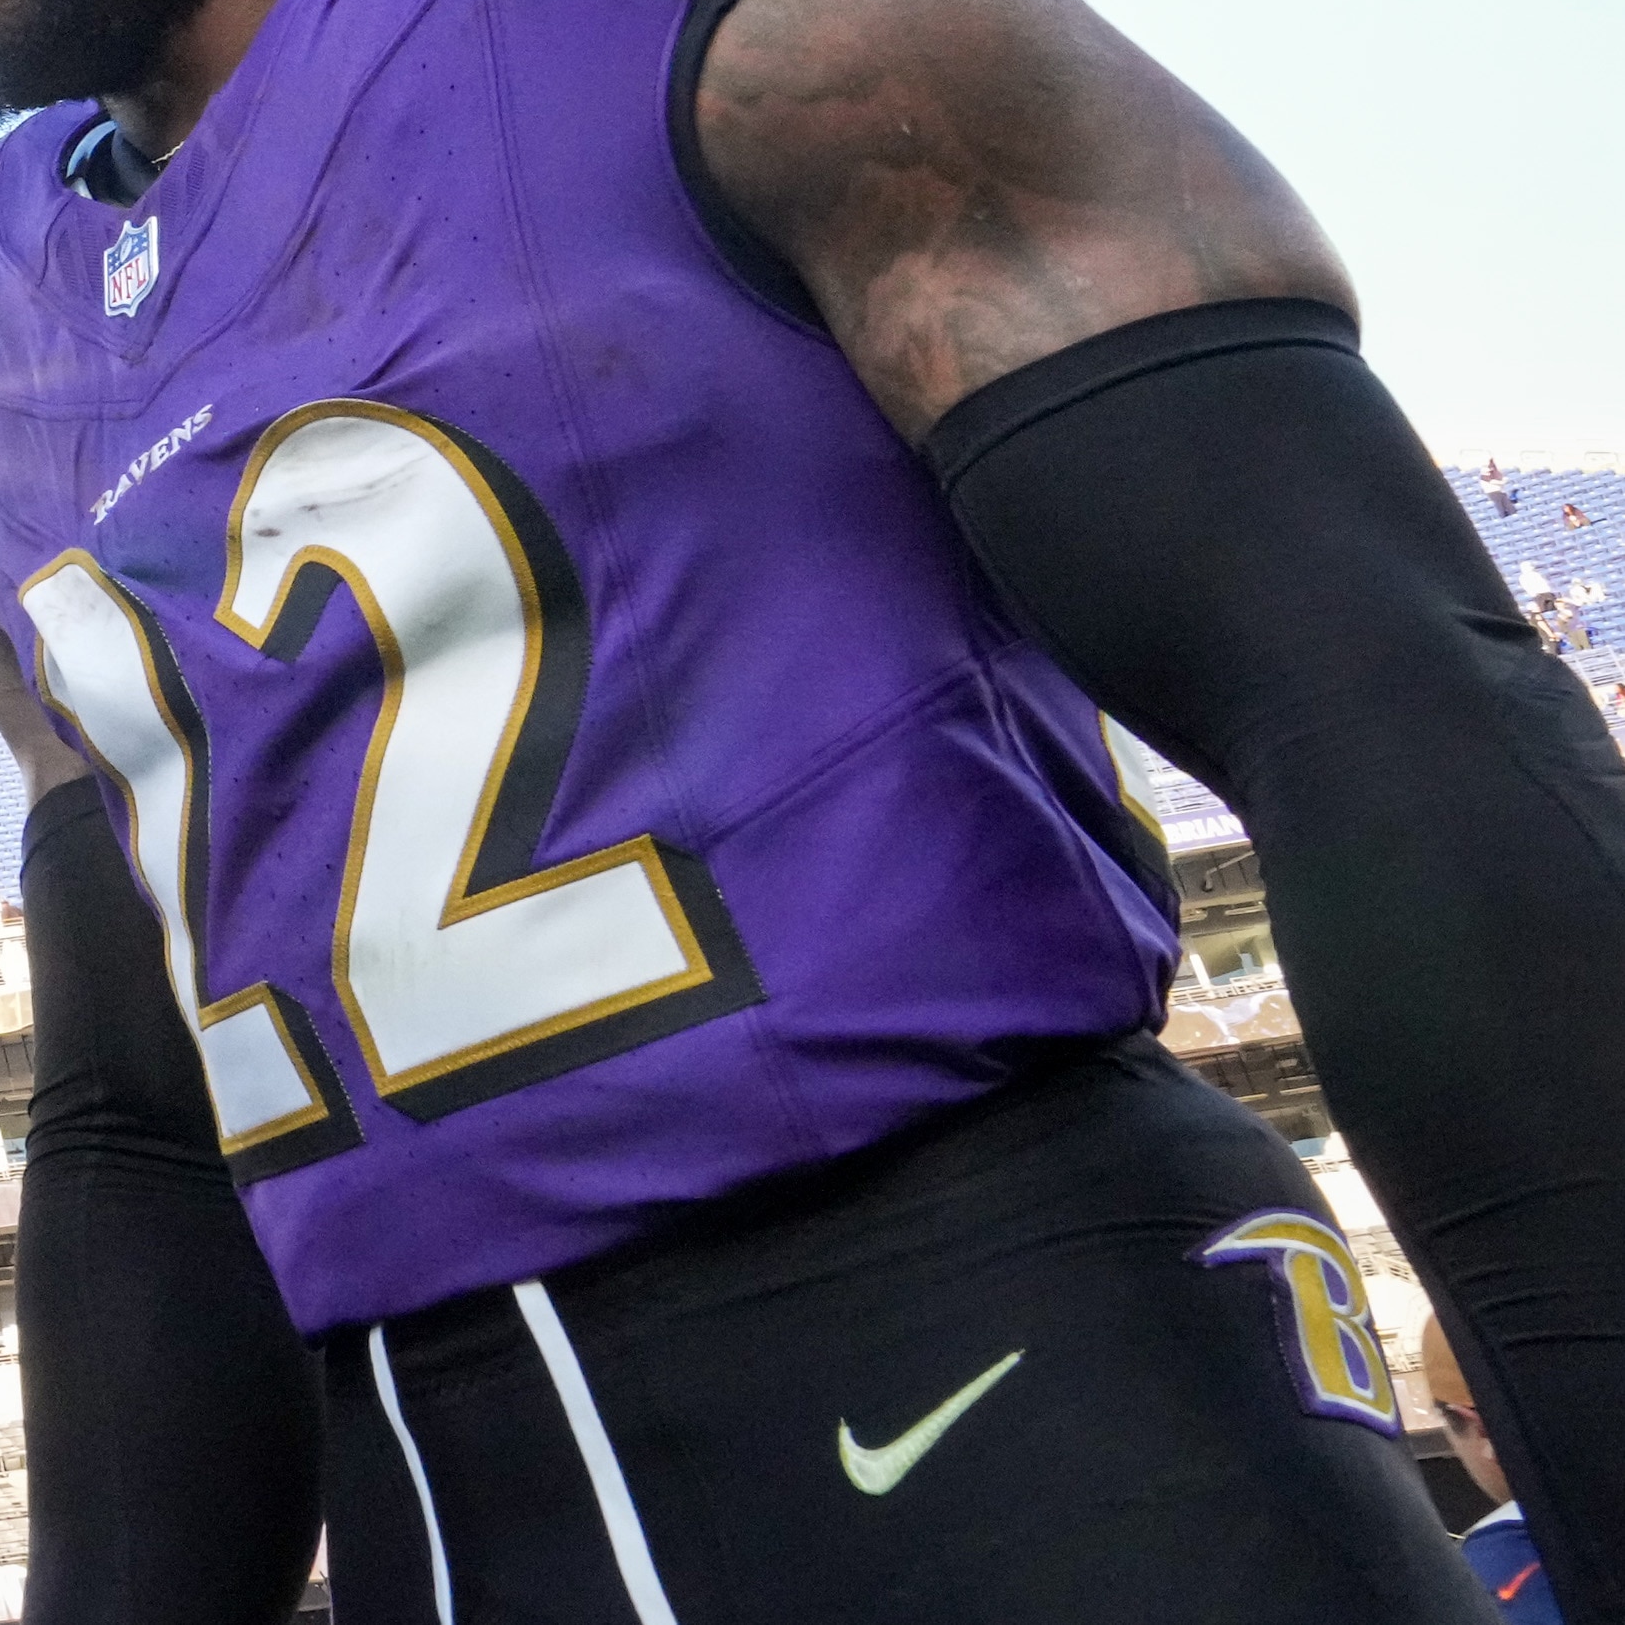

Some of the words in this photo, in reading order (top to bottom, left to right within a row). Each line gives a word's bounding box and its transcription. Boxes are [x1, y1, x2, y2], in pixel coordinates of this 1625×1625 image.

[111, 257, 147, 304] NFL
[89, 403, 213, 526] RAVENS
[18, 397, 740, 1160] 22
[1161, 814, 1245, 845] BRIAN
